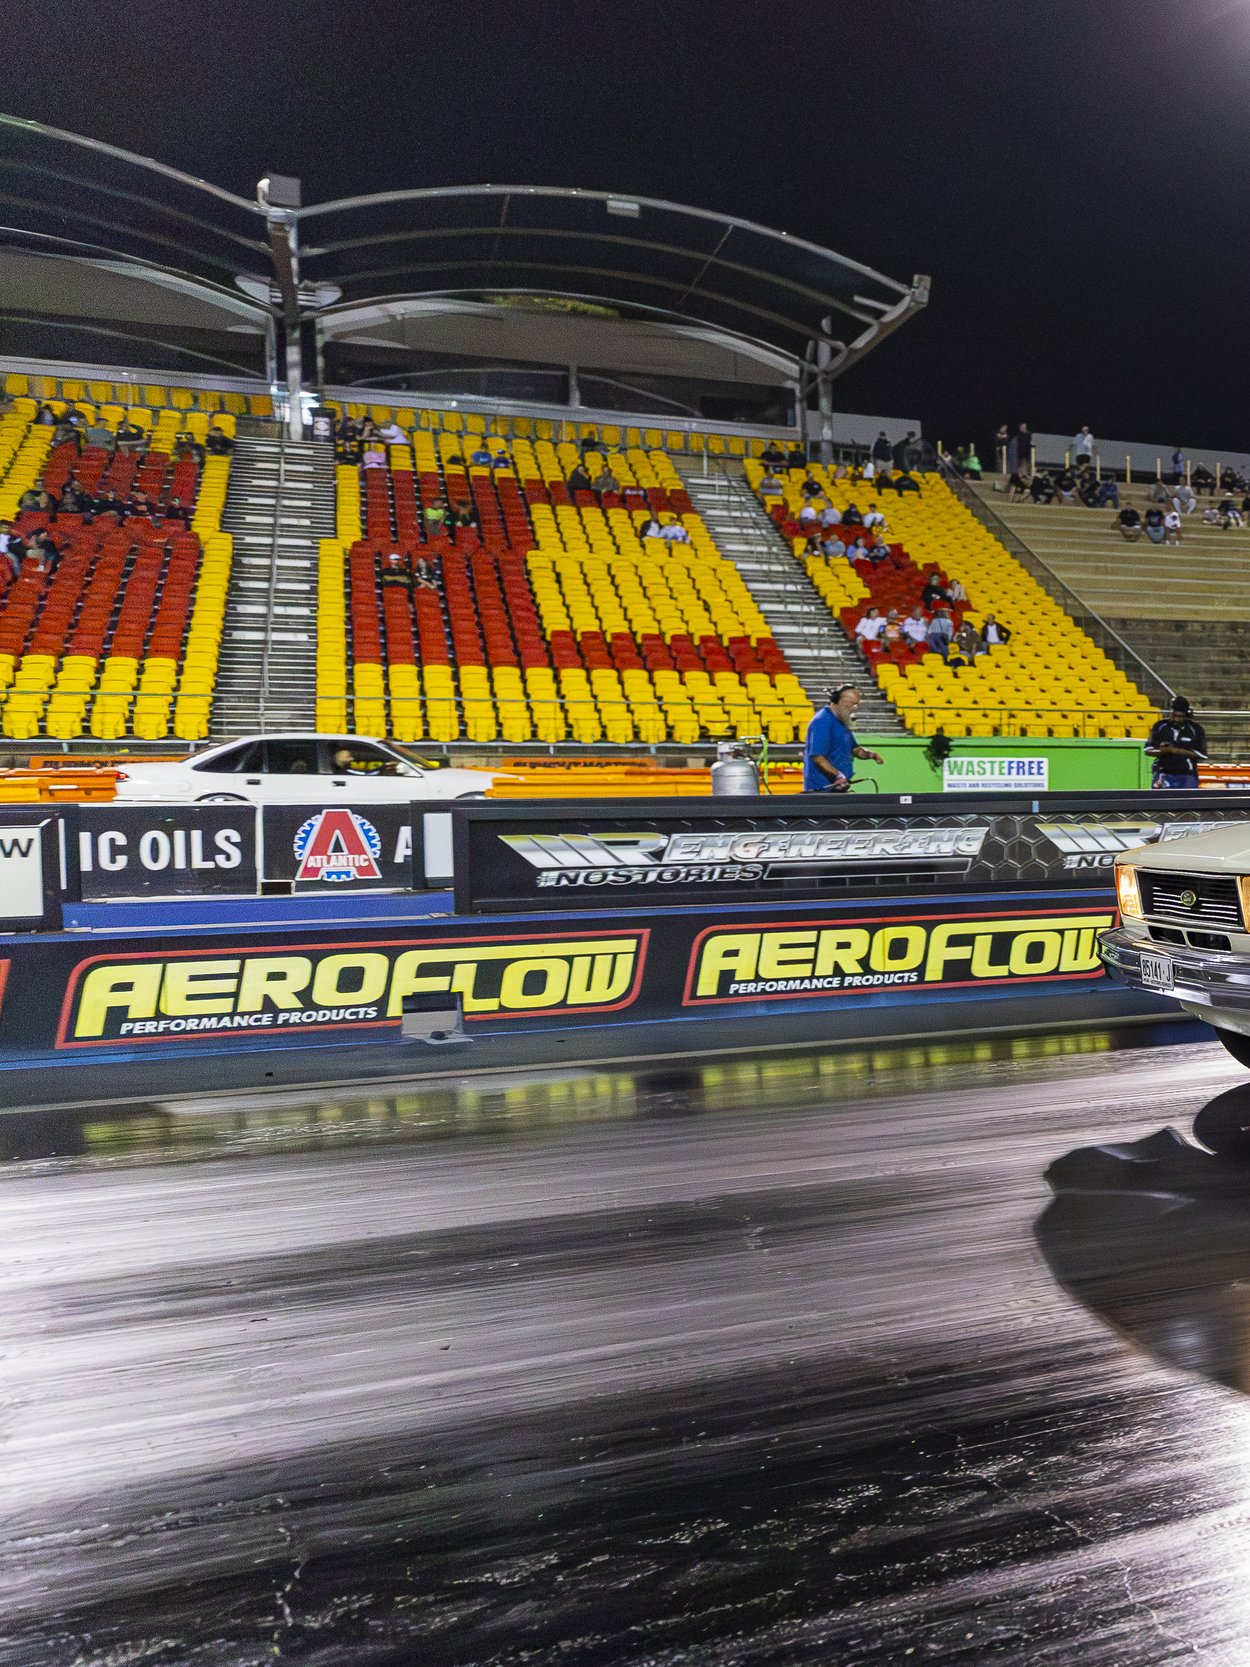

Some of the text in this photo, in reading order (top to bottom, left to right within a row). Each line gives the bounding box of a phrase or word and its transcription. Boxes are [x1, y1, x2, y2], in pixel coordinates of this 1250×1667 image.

[947, 760, 1044, 776] WASTEFREE
[139, 829, 242, 870] OILS
[307, 855, 369, 868] ATLANTIC
[662, 827, 989, 864] ENGINEERING
[696, 915, 1113, 996] AEROFLOW
[74, 939, 637, 1037] AEROFLOW
[729, 972, 919, 994] PERFORMANCE PRODUCTS
[120, 1006, 378, 1035] PERFORMANCE PRODUCTS
